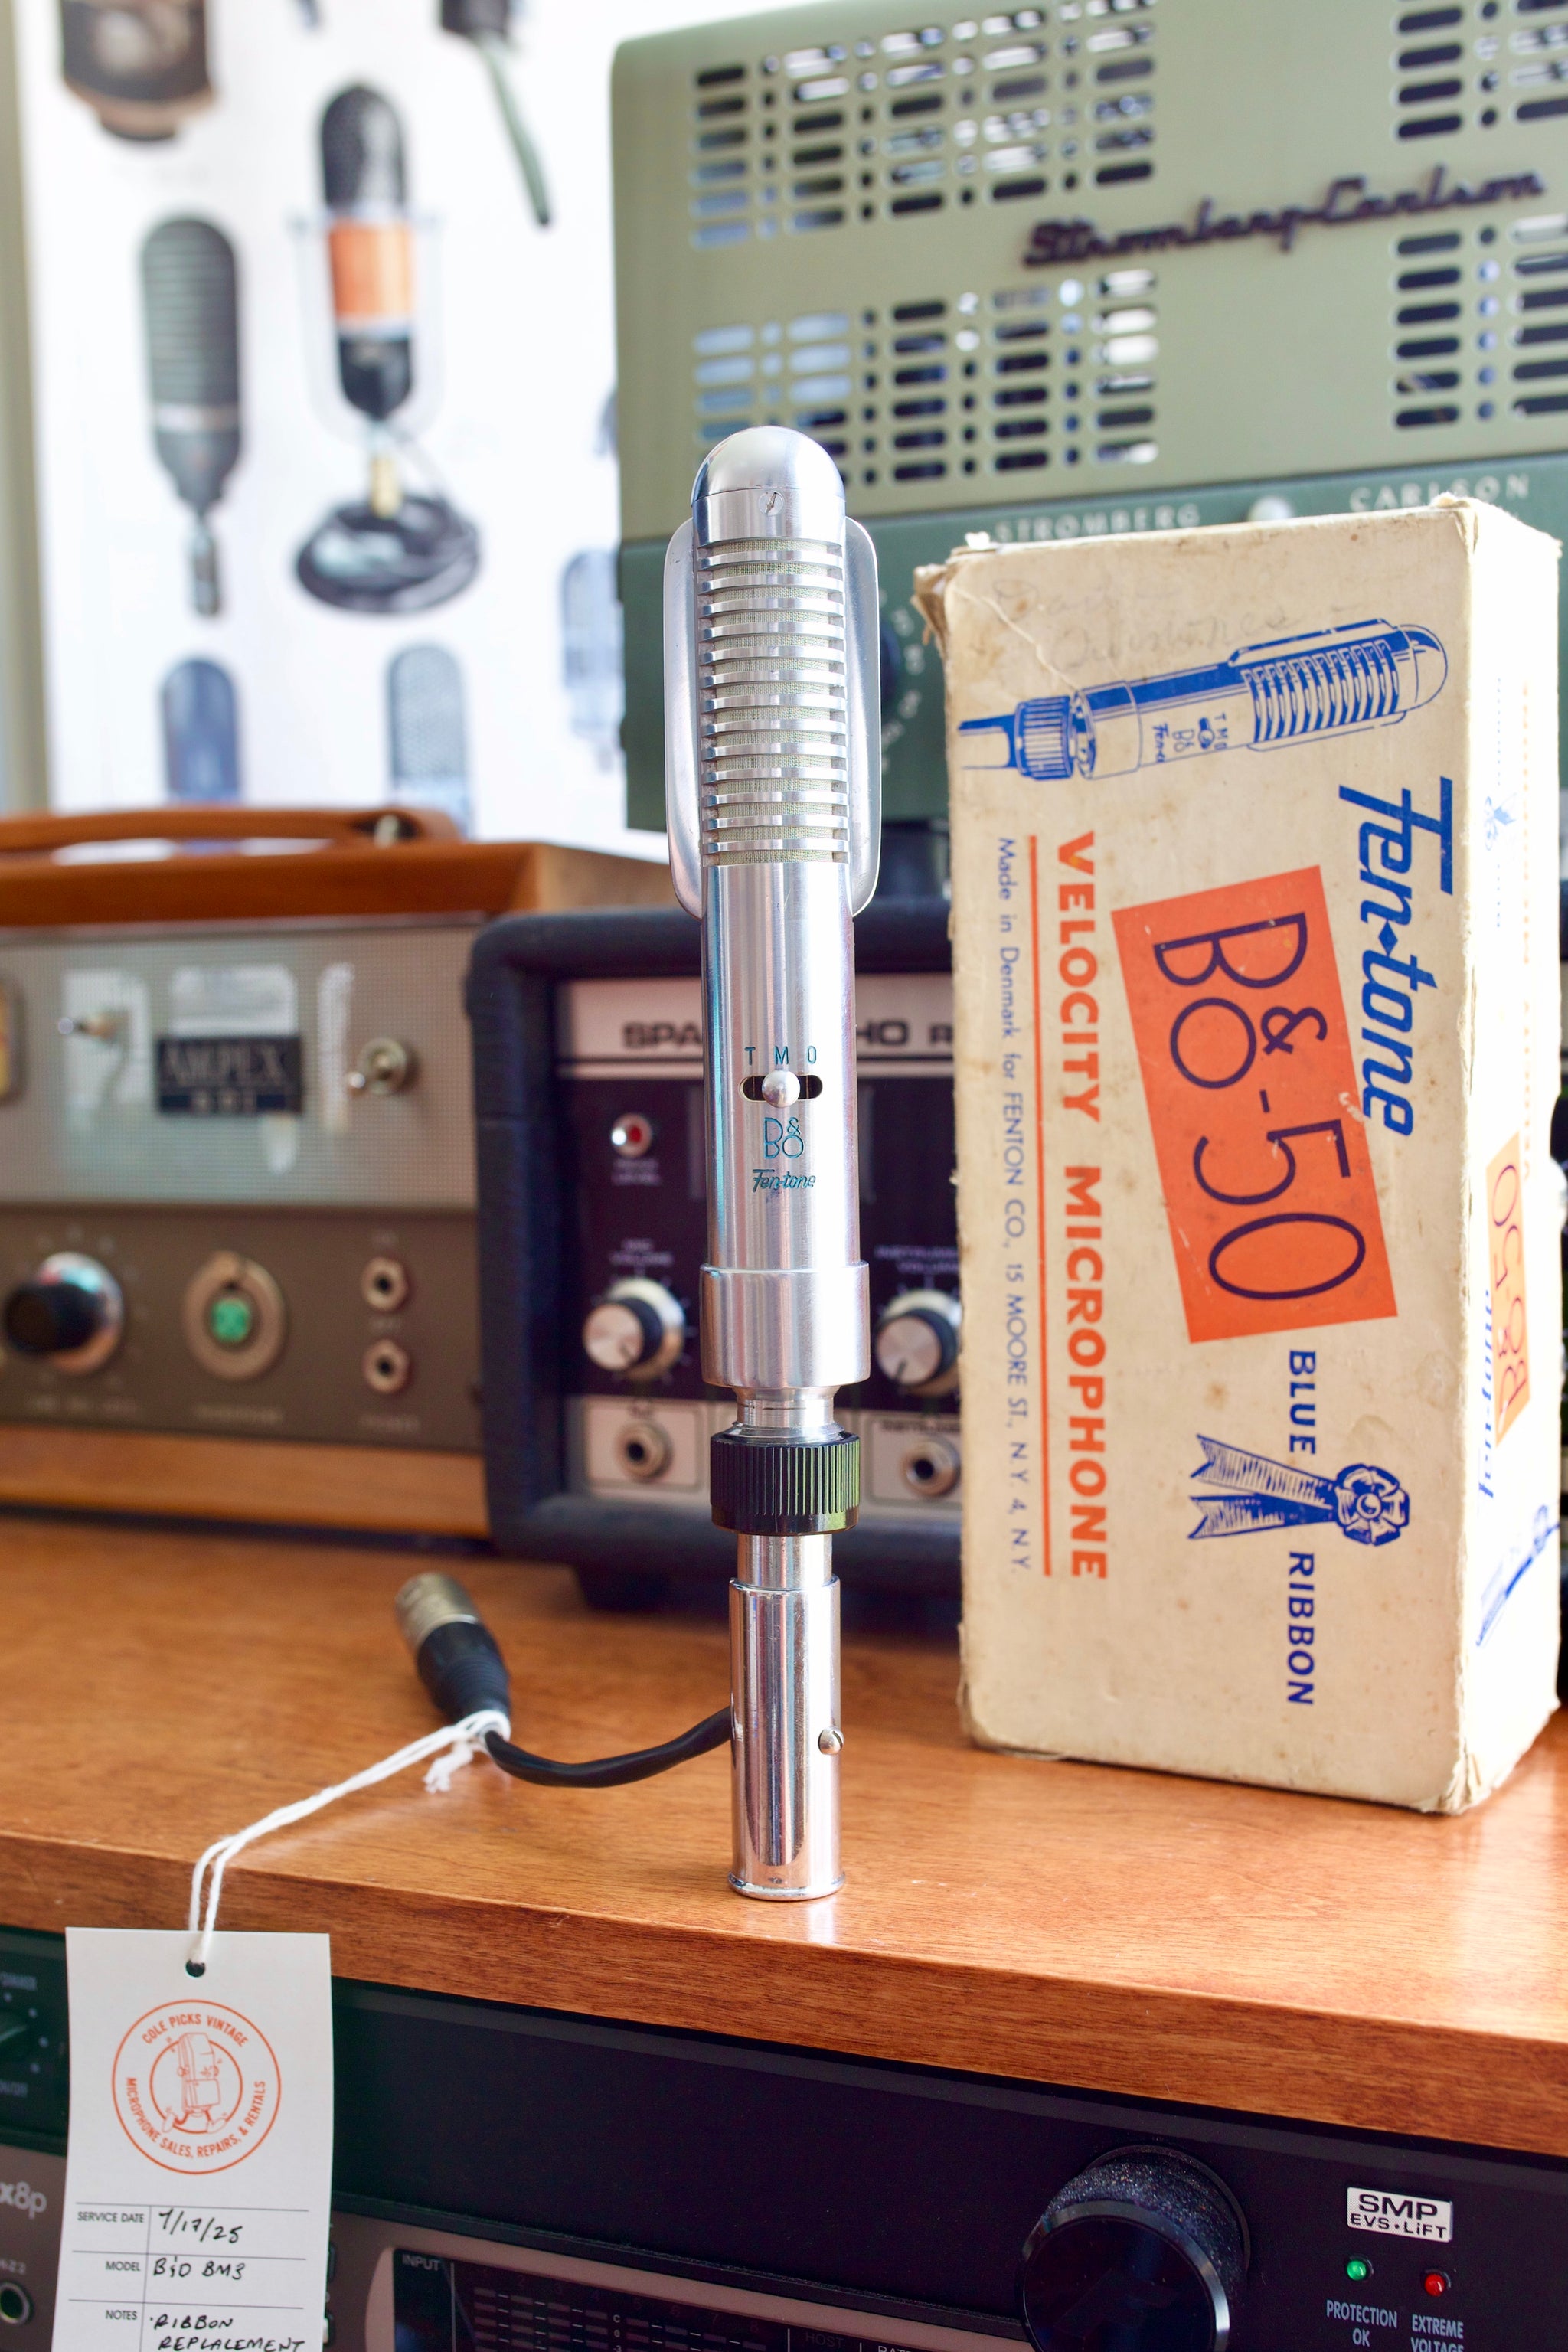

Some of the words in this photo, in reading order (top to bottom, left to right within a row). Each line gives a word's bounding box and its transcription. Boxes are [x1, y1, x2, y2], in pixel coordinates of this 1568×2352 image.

[998, 837, 1019, 900] Made
[1000, 913, 1018, 933] in
[1338, 776, 1454, 1138] Fen-tone
[1057, 830, 1101, 1124] VELOCITY
[999, 946, 1021, 1039] Denmark
[623, 1022, 702, 1050] SPA
[744, 1046, 756, 1066] T
[773, 1045, 789, 1065] M
[1002, 1053, 1023, 1080] for
[763, 1116, 805, 1160] B&O
[1003, 1091, 1024, 1186] FENTON
[753, 1168, 816, 1193] Fen-tone
[1006, 1263, 1024, 1283] 15
[1005, 1293, 1027, 1386] MOORE
[1064, 1165, 1108, 1579] MICROPHONE
[1289, 1350, 1317, 1456] BLUE
[1286, 1551, 1315, 1706] RIBBON
[142, 2020, 168, 2045] COLE
[168, 2013, 201, 2028] PICKS
[207, 2015, 249, 2048] VINTAGE
[126, 2077, 161, 2143] MICROPHONE
[243, 2079, 266, 2128] RENTALS
[238, 2125, 250, 2137] &
[159, 2137, 194, 2159] SALES,
[197, 2133, 243, 2158] REPAIRS,
[77, 2211, 118, 2223] SERVICE
[121, 2213, 145, 2223] DATE
[1358, 2194, 1438, 2220] SMP
[158, 2207, 243, 2244] 7/17/25
[105, 2261, 141, 2272] MODEL
[202, 2260, 246, 2281] BM3
[402, 2253, 442, 2272] INPUT
[105, 2309, 138, 2321] NOTES
[1325, 2298, 1398, 2329] PROTECTION
[1411, 2314, 1464, 2339] EXTREME
[1352, 2328, 1370, 2347] OK
